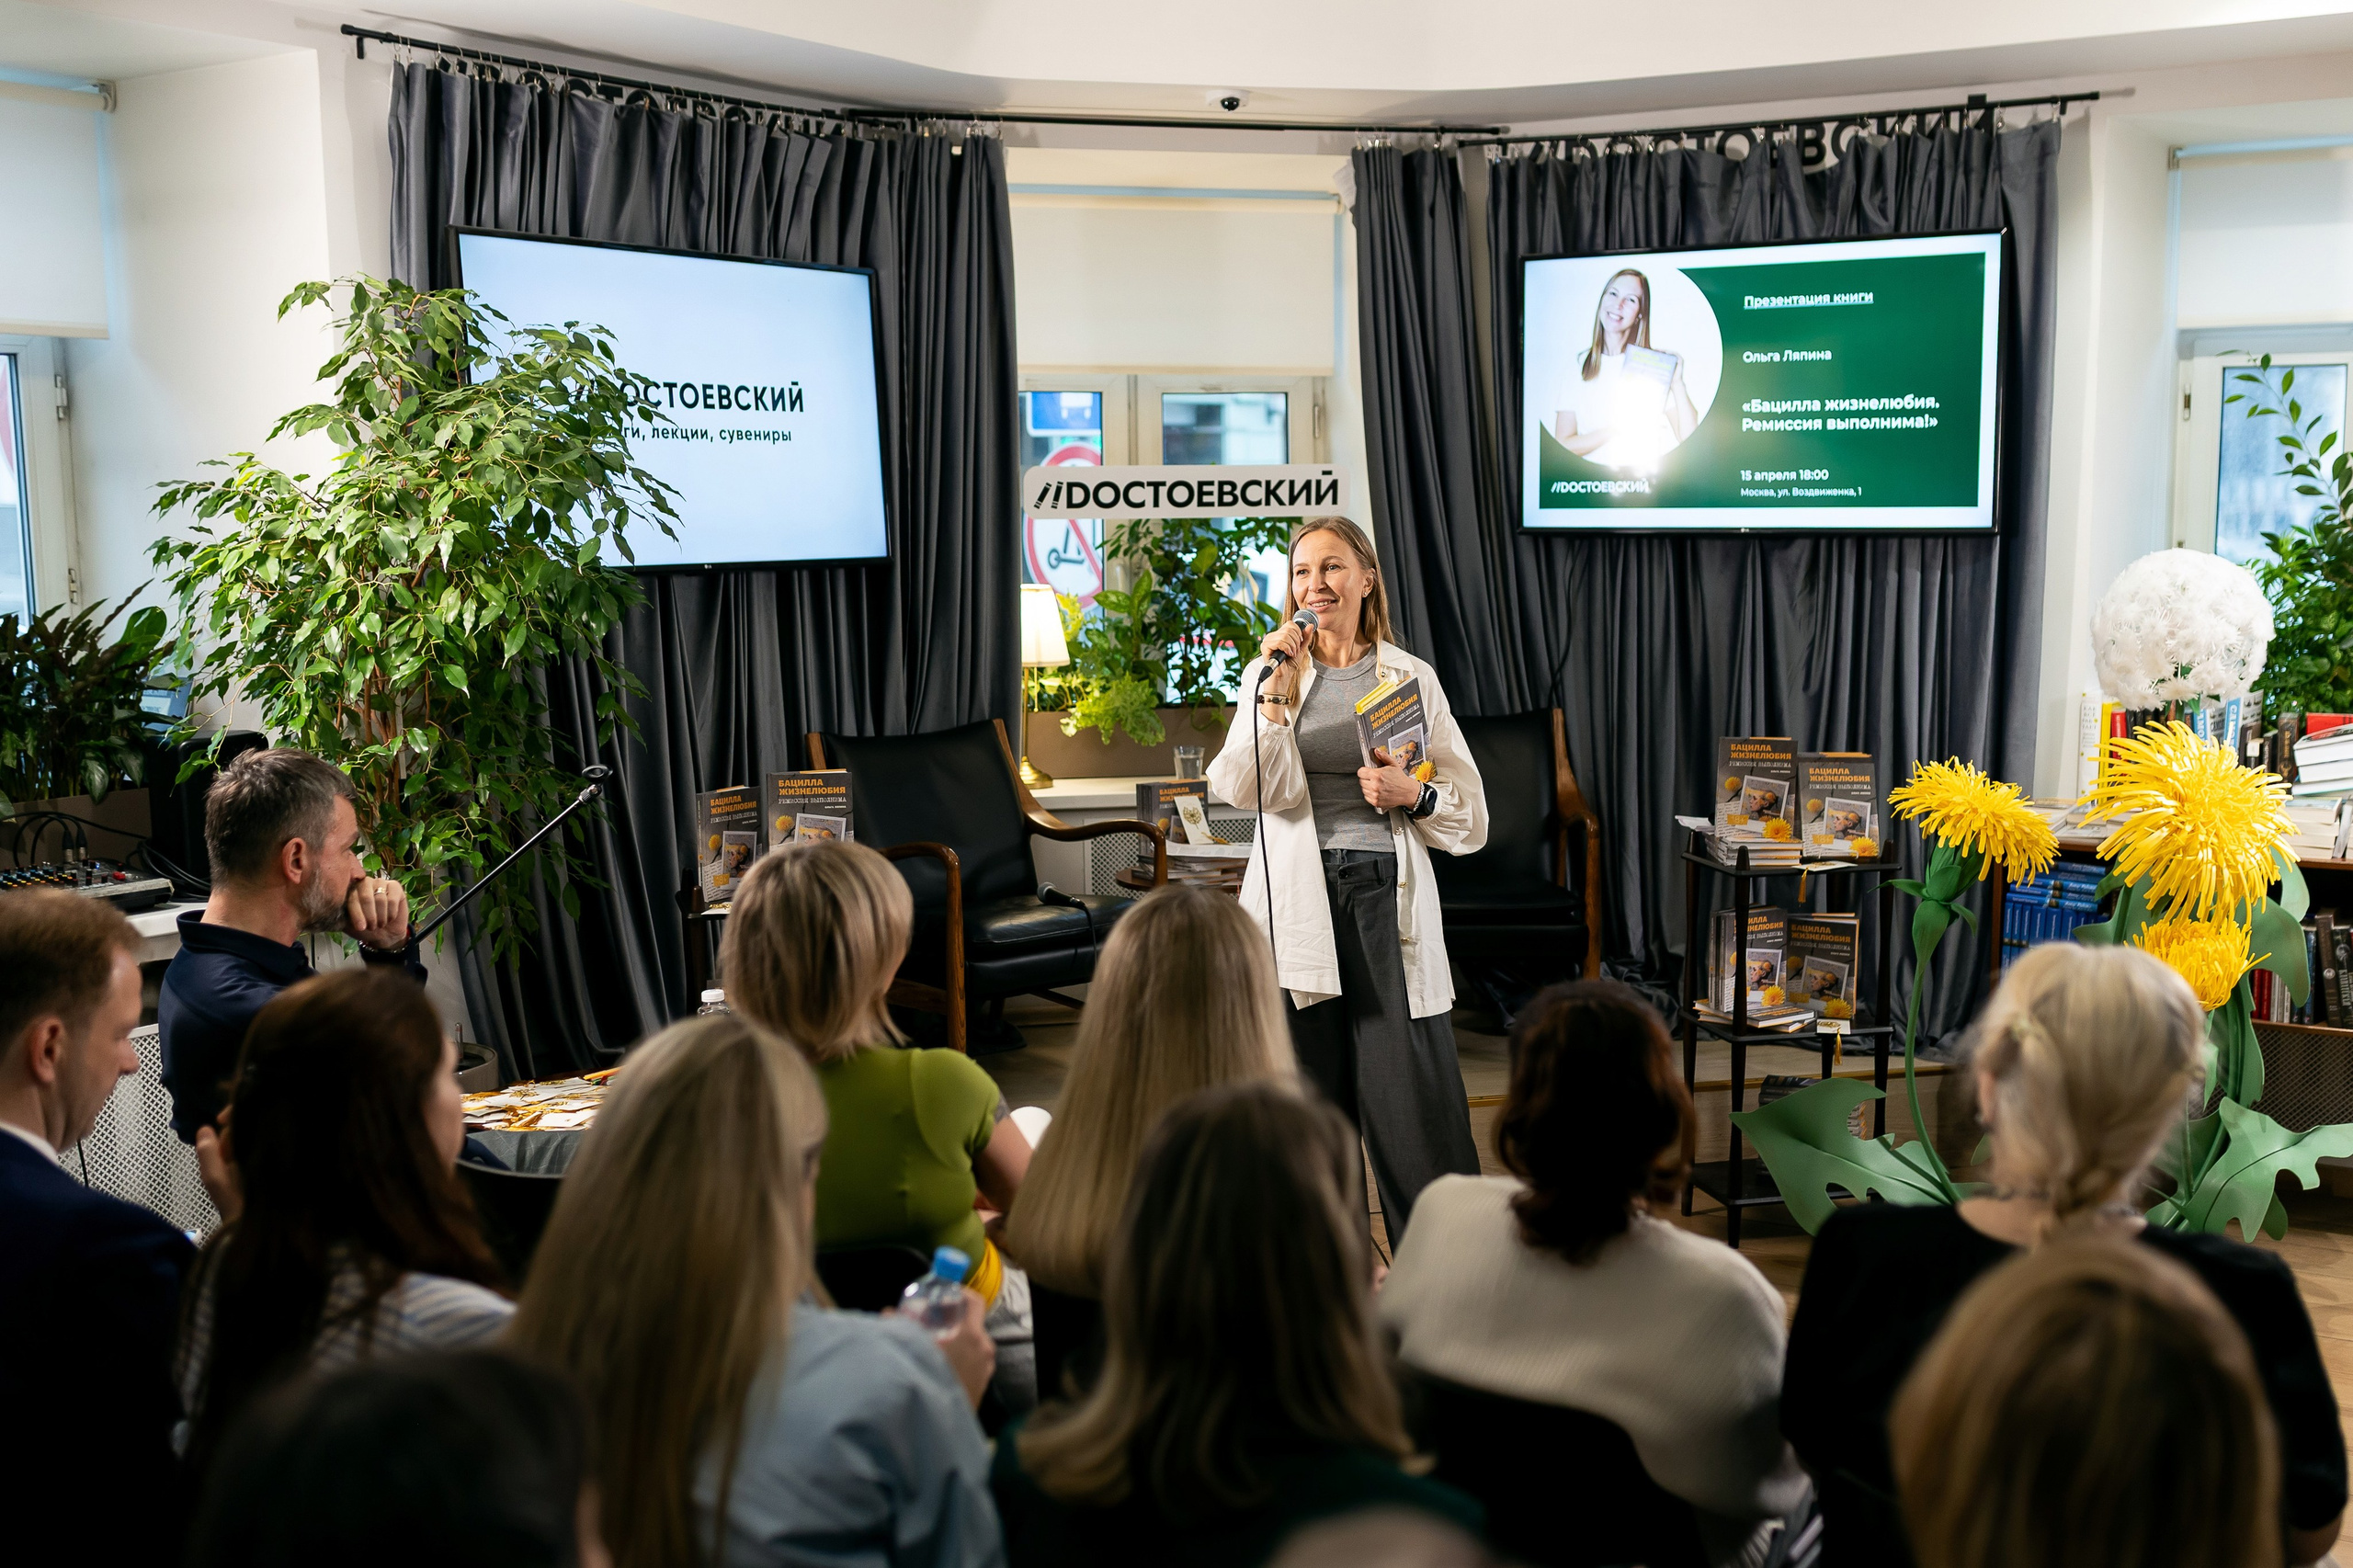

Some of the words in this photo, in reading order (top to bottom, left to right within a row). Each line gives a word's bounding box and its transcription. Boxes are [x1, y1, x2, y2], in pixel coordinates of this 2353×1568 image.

[1744, 293, 1830, 309] Презентация
[1834, 291, 1874, 304] книги
[1743, 351, 1780, 363] Ольга
[1783, 349, 1832, 362] Ляпина
[1742, 398, 1822, 414] «Бацилла
[1824, 393, 1940, 412] жизнелюбия.
[1742, 416, 1823, 432] Ремиссия
[1826, 414, 1938, 430] выполнима!»
[652, 427, 713, 442] лекции,
[719, 427, 791, 445] сувениры
[1740, 470, 1752, 482] 15
[1754, 471, 1797, 483] апреля
[1799, 469, 1829, 481] 18:00
[1740, 487, 1776, 497] Москва,
[1777, 489, 1790, 498] ул.
[1792, 487, 1857, 497] Воздвиженка,
[1858, 486, 1862, 496] 1
[1370, 697, 1402, 722] БАЦИЛЛА
[1372, 694, 1418, 730] ЖИЗНЕЛЮБИЯ
[1730, 744, 1772, 752] БАЦИЛЛА
[1730, 752, 1792, 760] ЖИЗНЕЛЮБИЯ
[778, 778, 824, 788] БАЦИЛЛА
[779, 786, 847, 796] ЖИЗНЕЛЮБИЯ
[710, 795, 742, 807] БАЦИЛЛА
[710, 801, 757, 815] ЖИЗНЕЛЮБИЯ
[1791, 924, 1831, 934] БАЦИЛЛА
[1791, 932, 1851, 943] ЖИЗНЕЛЮБИЯ
